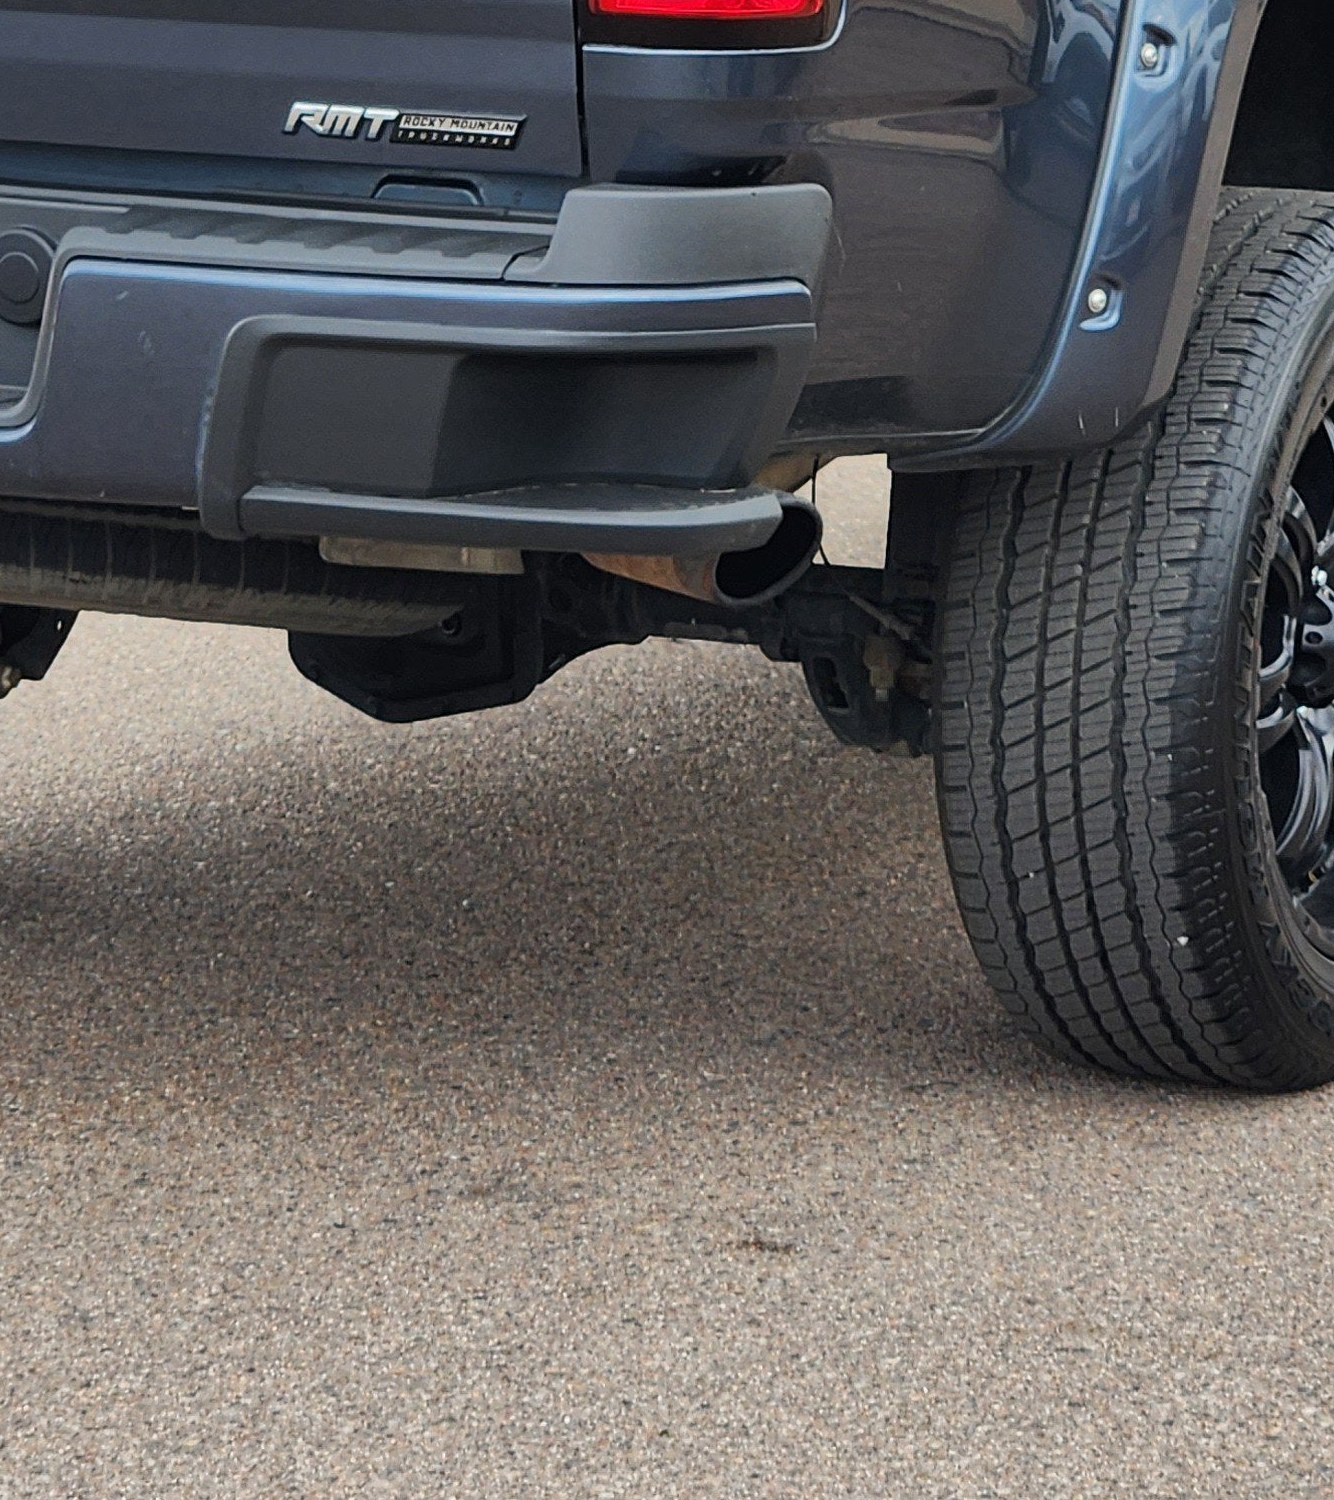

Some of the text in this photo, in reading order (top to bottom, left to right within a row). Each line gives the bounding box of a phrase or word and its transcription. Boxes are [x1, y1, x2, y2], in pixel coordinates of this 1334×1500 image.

[282, 100, 400, 140] RMT
[402, 115, 516, 133] ROCKY MOUNTAIN
